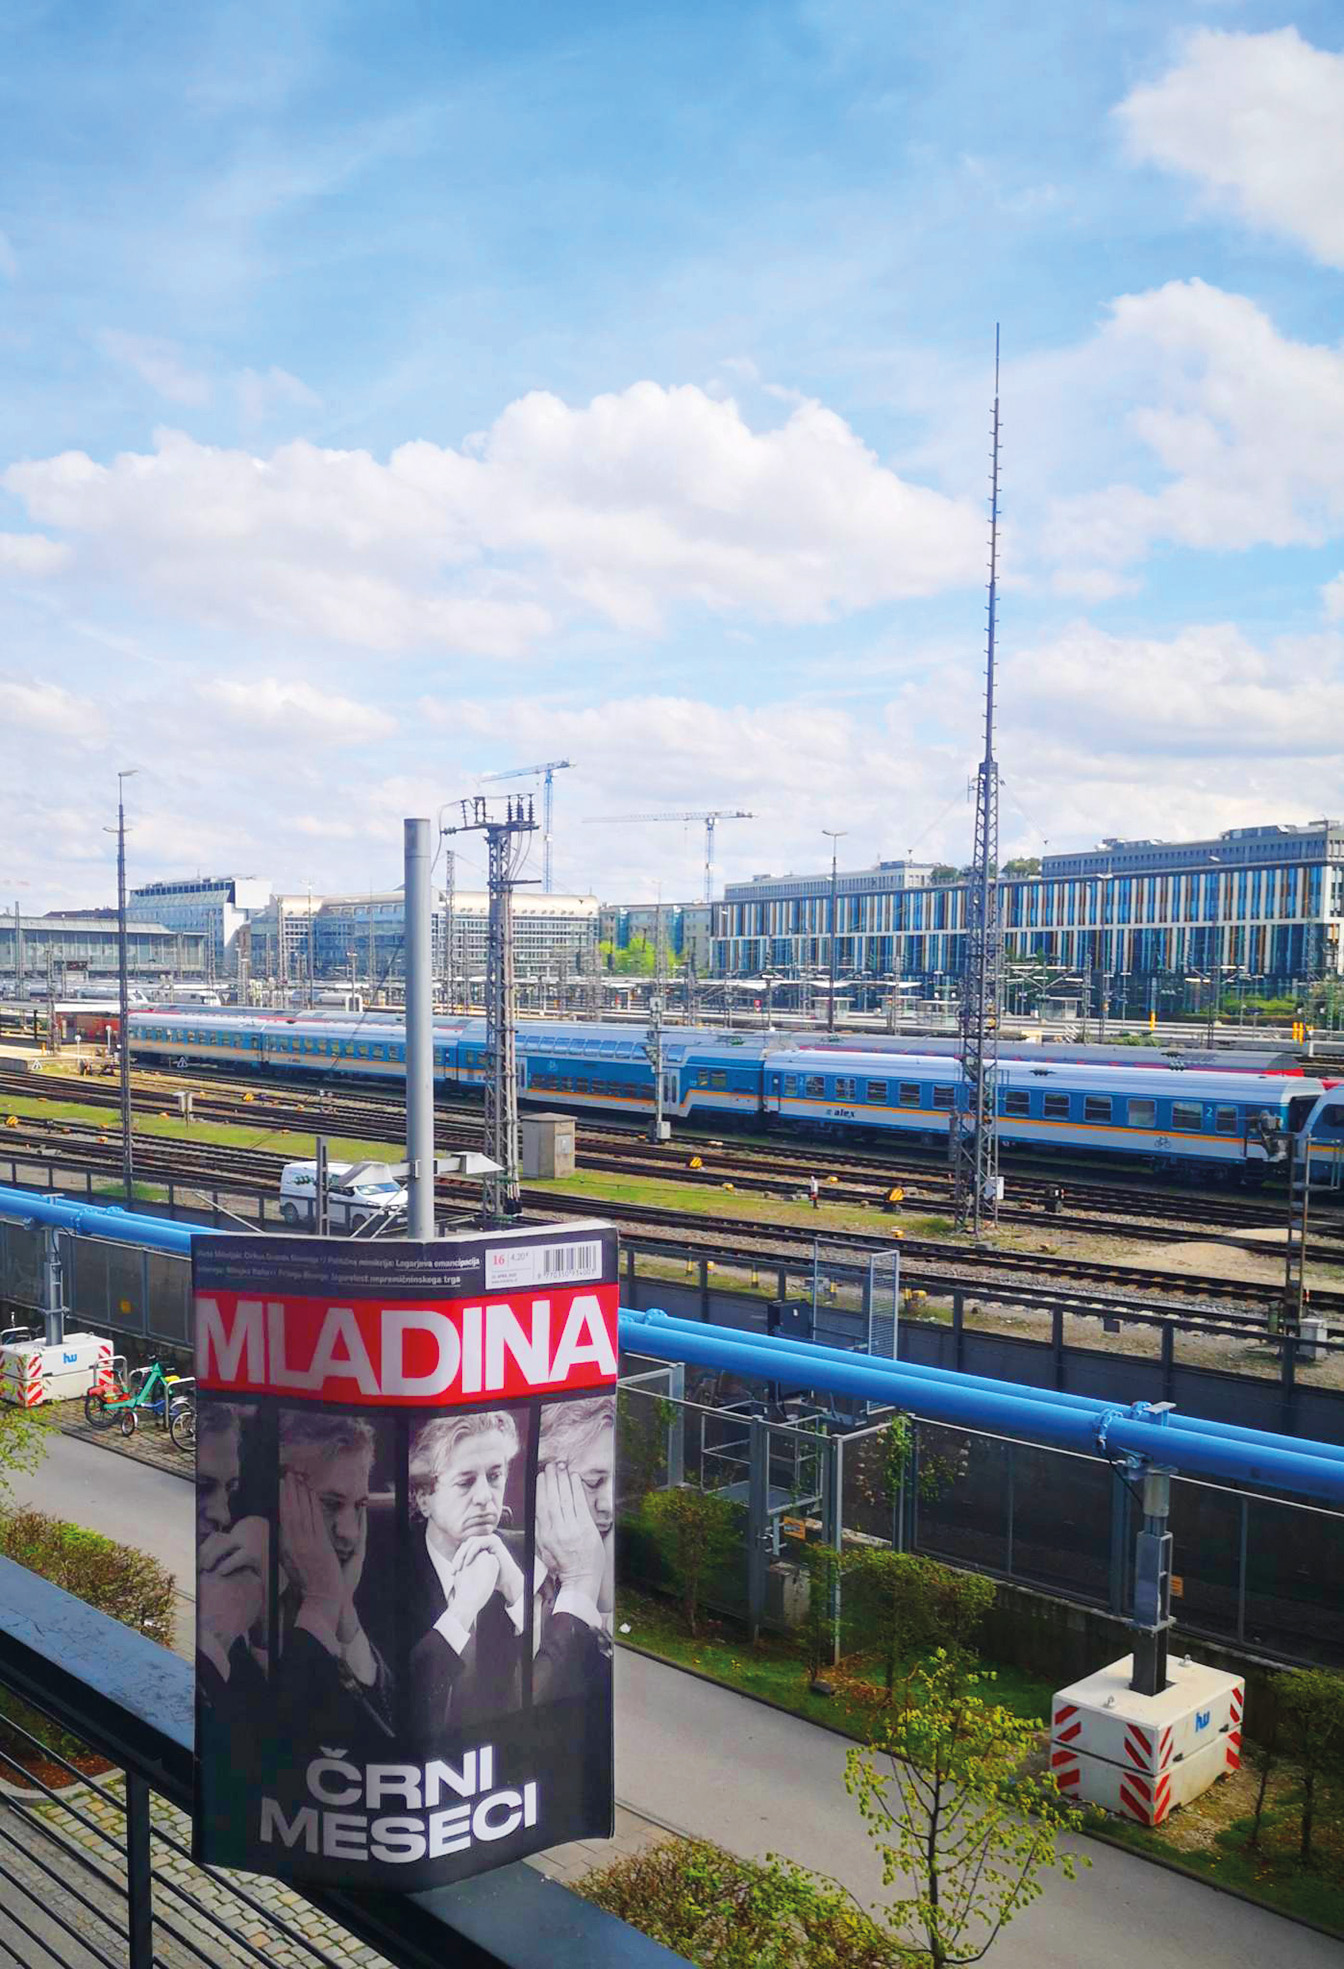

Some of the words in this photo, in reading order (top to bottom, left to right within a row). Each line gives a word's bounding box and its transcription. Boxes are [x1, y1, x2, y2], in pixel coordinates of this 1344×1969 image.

[833, 1108, 855, 1118] alex
[1206, 1106, 1214, 1118] 2
[493, 1254, 505, 1266] 16
[198, 1295, 618, 1397] MLADINA
[305, 1745, 493, 1810] ČRNI
[259, 1781, 537, 1864] MESECI
